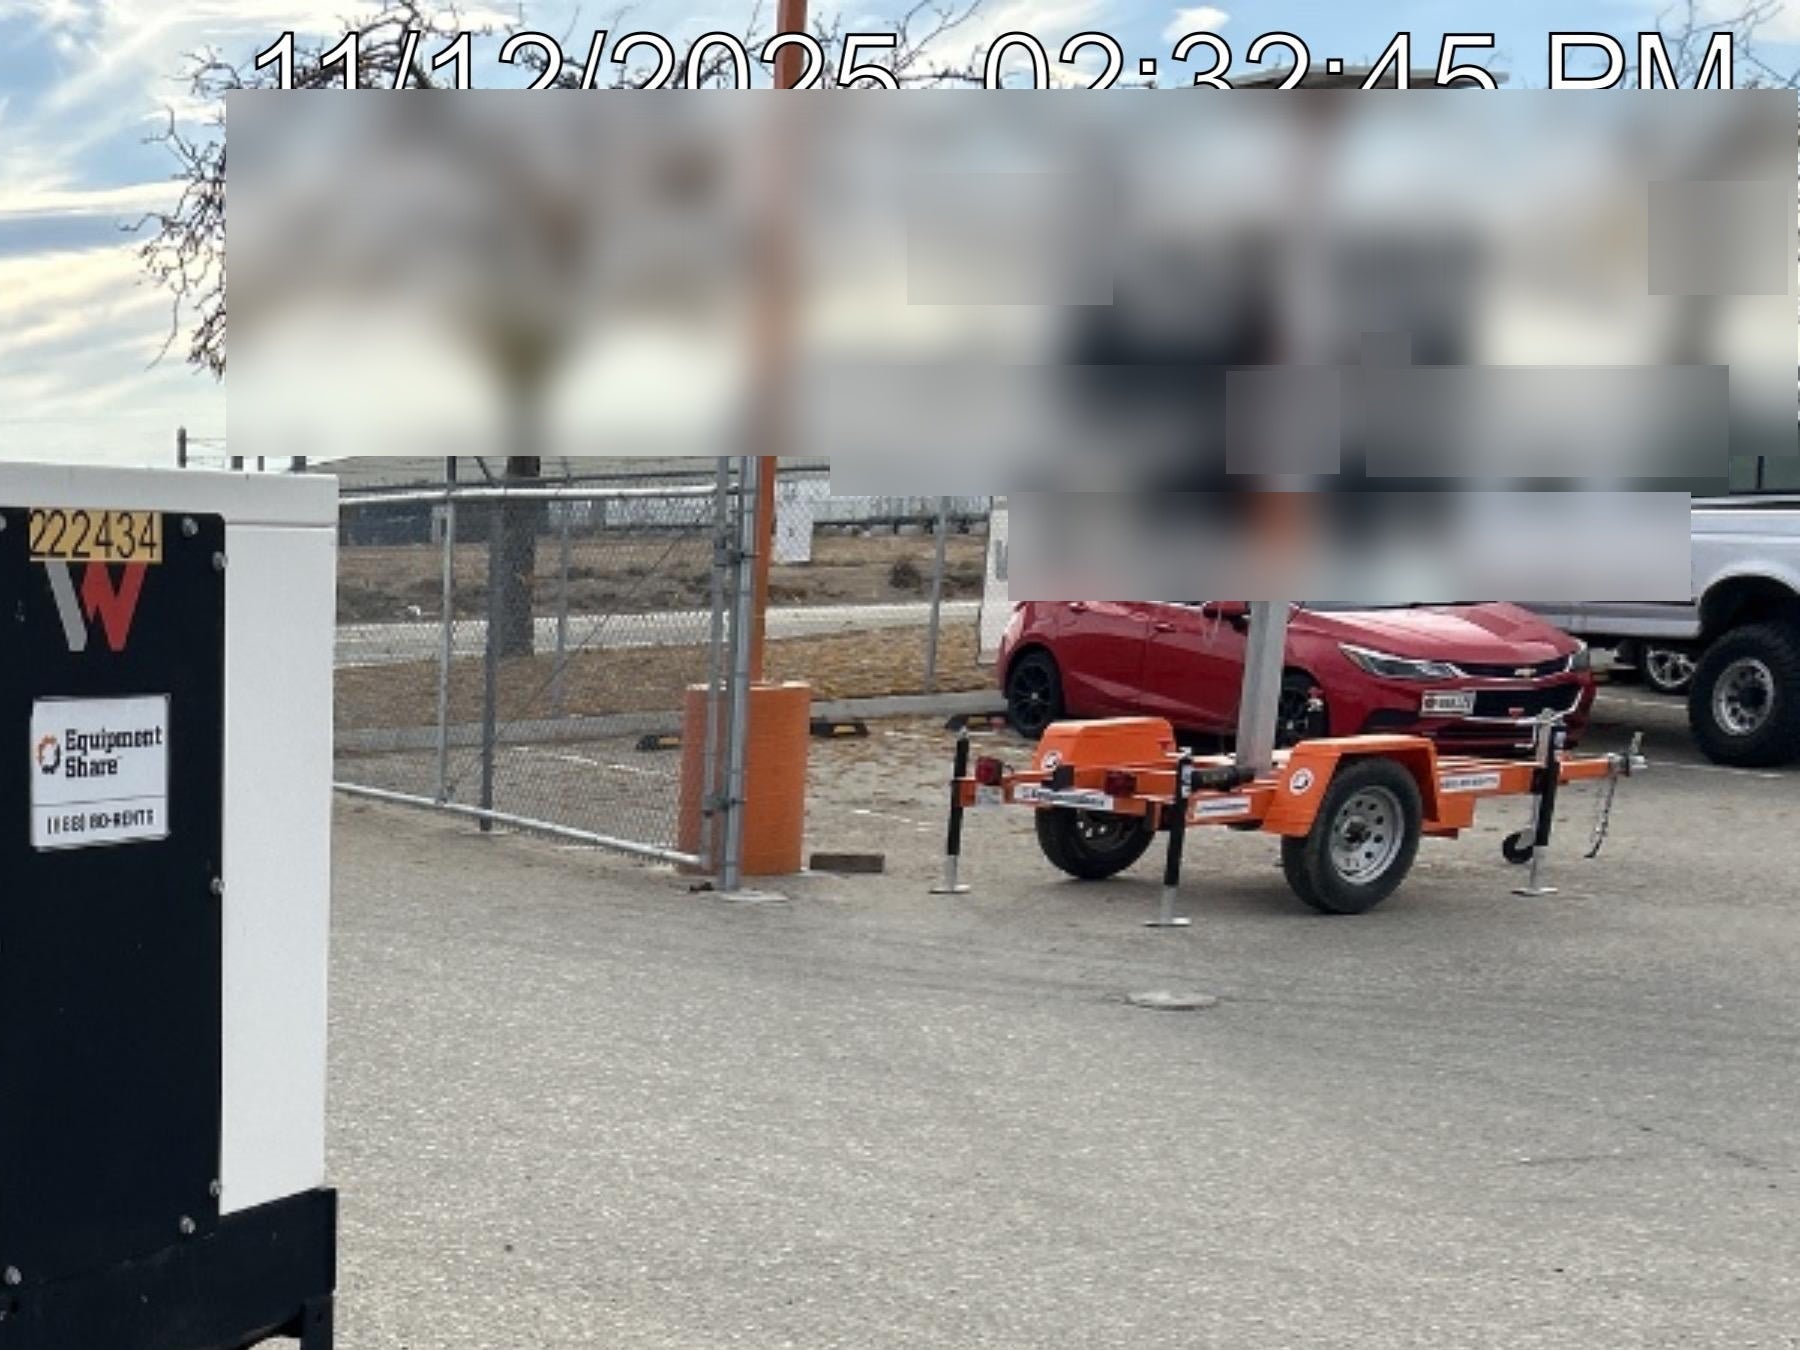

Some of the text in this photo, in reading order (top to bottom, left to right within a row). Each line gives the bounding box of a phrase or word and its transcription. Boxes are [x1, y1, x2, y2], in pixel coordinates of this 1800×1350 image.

[29, 508, 157, 558] 222434
[64, 724, 163, 756] Equipment
[64, 755, 119, 779] Share
